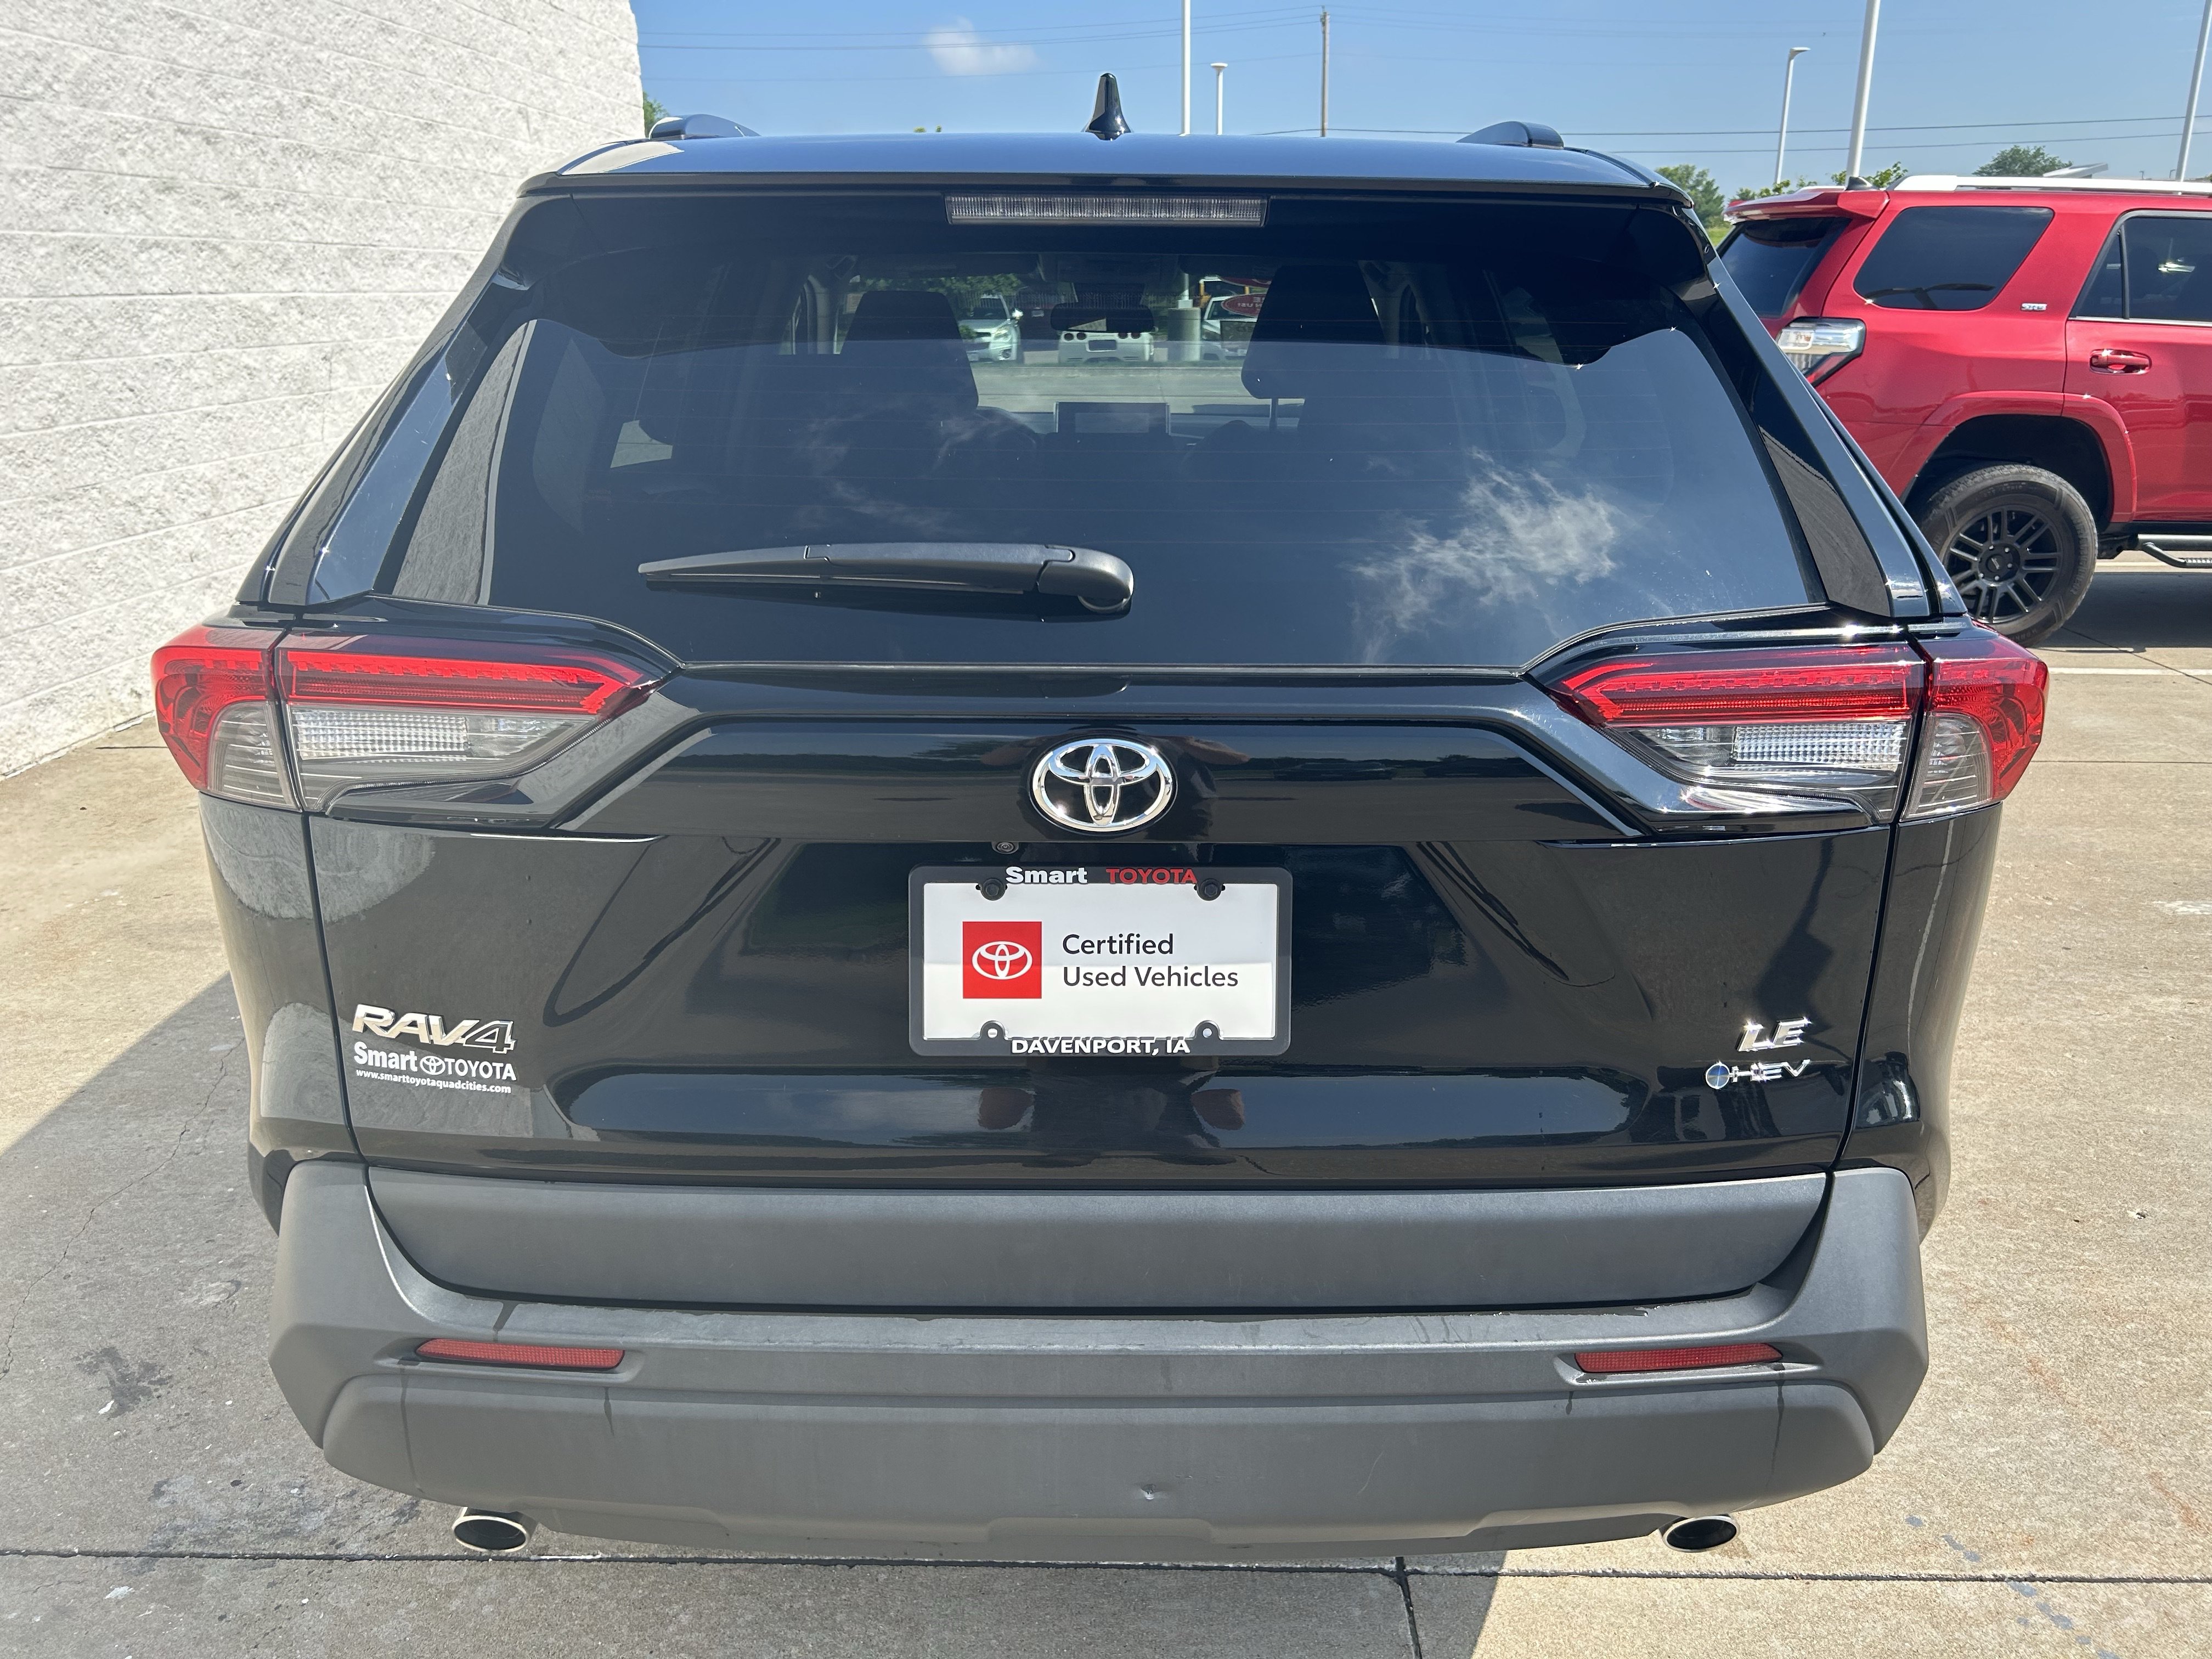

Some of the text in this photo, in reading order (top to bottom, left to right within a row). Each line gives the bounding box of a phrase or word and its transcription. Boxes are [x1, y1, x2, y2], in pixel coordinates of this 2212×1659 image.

[1006, 867, 1198, 884] Smart TOYOTA
[1062, 933, 1173, 955] Certified
[1063, 966, 1238, 987] Used Vehicles
[352, 1003, 517, 1054] RAV4
[1735, 1017, 1812, 1052] LE
[1012, 1037, 1190, 1056] DAVENPORT, IA
[354, 1041, 517, 1081] Smart TOYOTA
[356, 1069, 511, 1093] www.smarttoyotaquadcities.com
